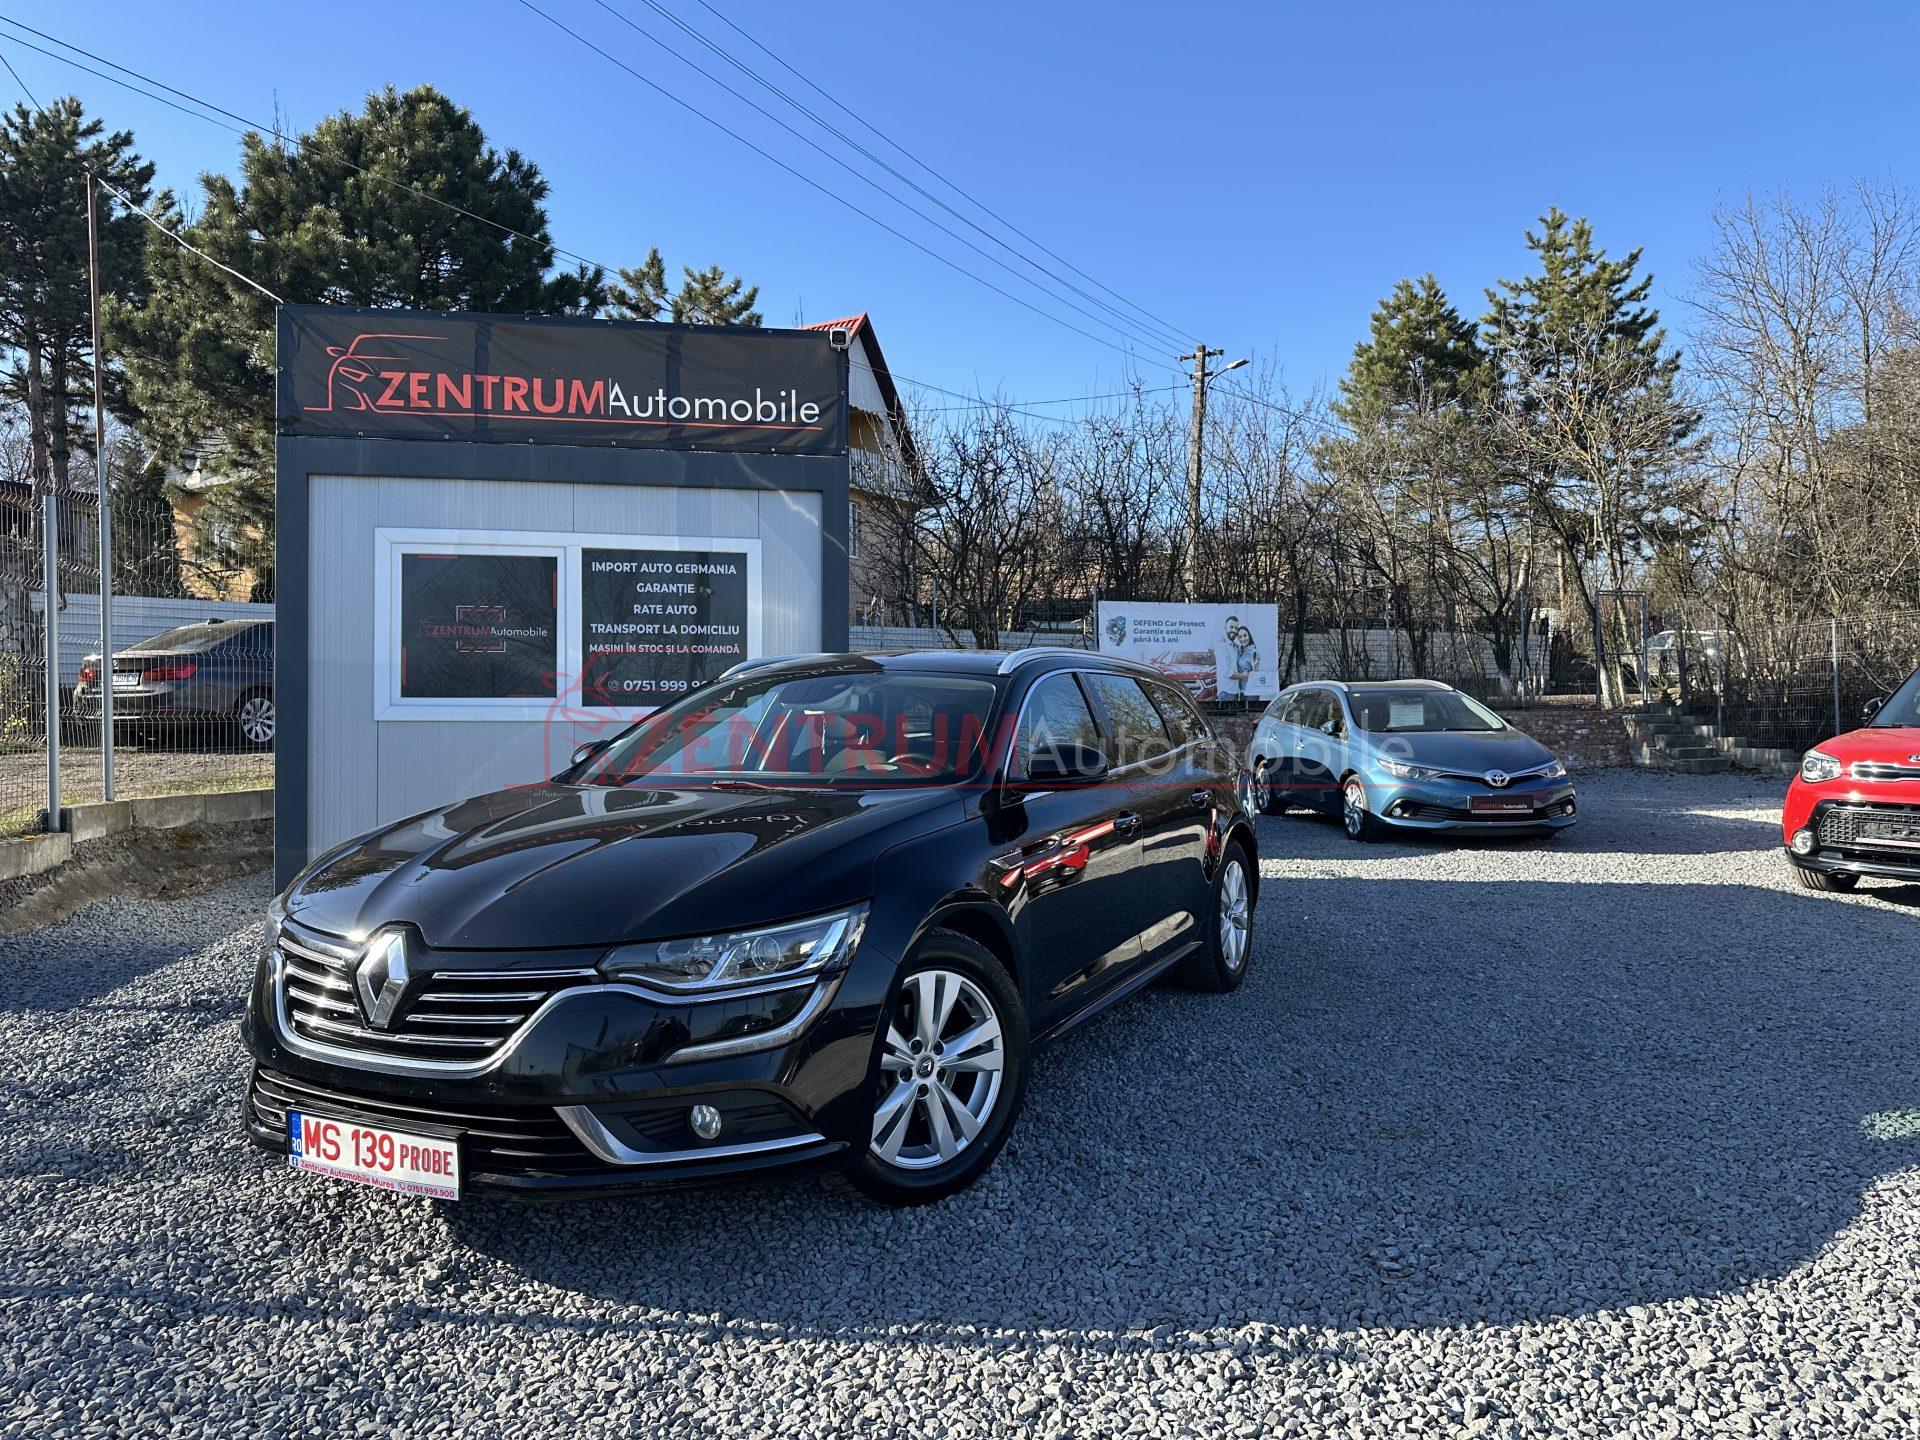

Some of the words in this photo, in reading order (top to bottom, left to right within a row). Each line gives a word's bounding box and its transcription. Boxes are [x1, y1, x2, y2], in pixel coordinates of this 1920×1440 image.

[376, 371, 604, 415] ZENTRUM
[609, 380, 820, 424] Automobile
[591, 562, 637, 573] IMPORT
[640, 563, 672, 573] AUTO
[676, 564, 737, 575] GERMANIA
[636, 582, 695, 597] GARANȚIE
[633, 604, 663, 615] RATE
[666, 605, 697, 615] AUTO
[590, 623, 660, 635] TRANSPORT
[663, 624, 677, 635] LA
[680, 625, 740, 635] DOMICILIU
[1133, 619, 1163, 627] DEFEND
[432, 625, 490, 635] ZENTRUM
[490, 626, 548, 637] Automobile
[589, 643, 623, 655] MAȘINI
[626, 642, 636, 653] ÎN
[638, 644, 663, 653] STOC
[665, 644, 674, 656] ȘI
[677, 644, 689, 654] LA
[691, 643, 740, 654] COMANDĂ
[623, 680, 656, 692] 0751
[660, 680, 687, 692] 999
[291, 1137, 302, 1153] RO
[303, 1119, 341, 1161] MS
[351, 1128, 395, 1172] 139
[400, 1143, 454, 1177] PROBE
[301, 1160, 328, 1174] Zentrum
[329, 1166, 371, 1185] Automobile
[407, 1184, 455, 1198] 0751.999.900
